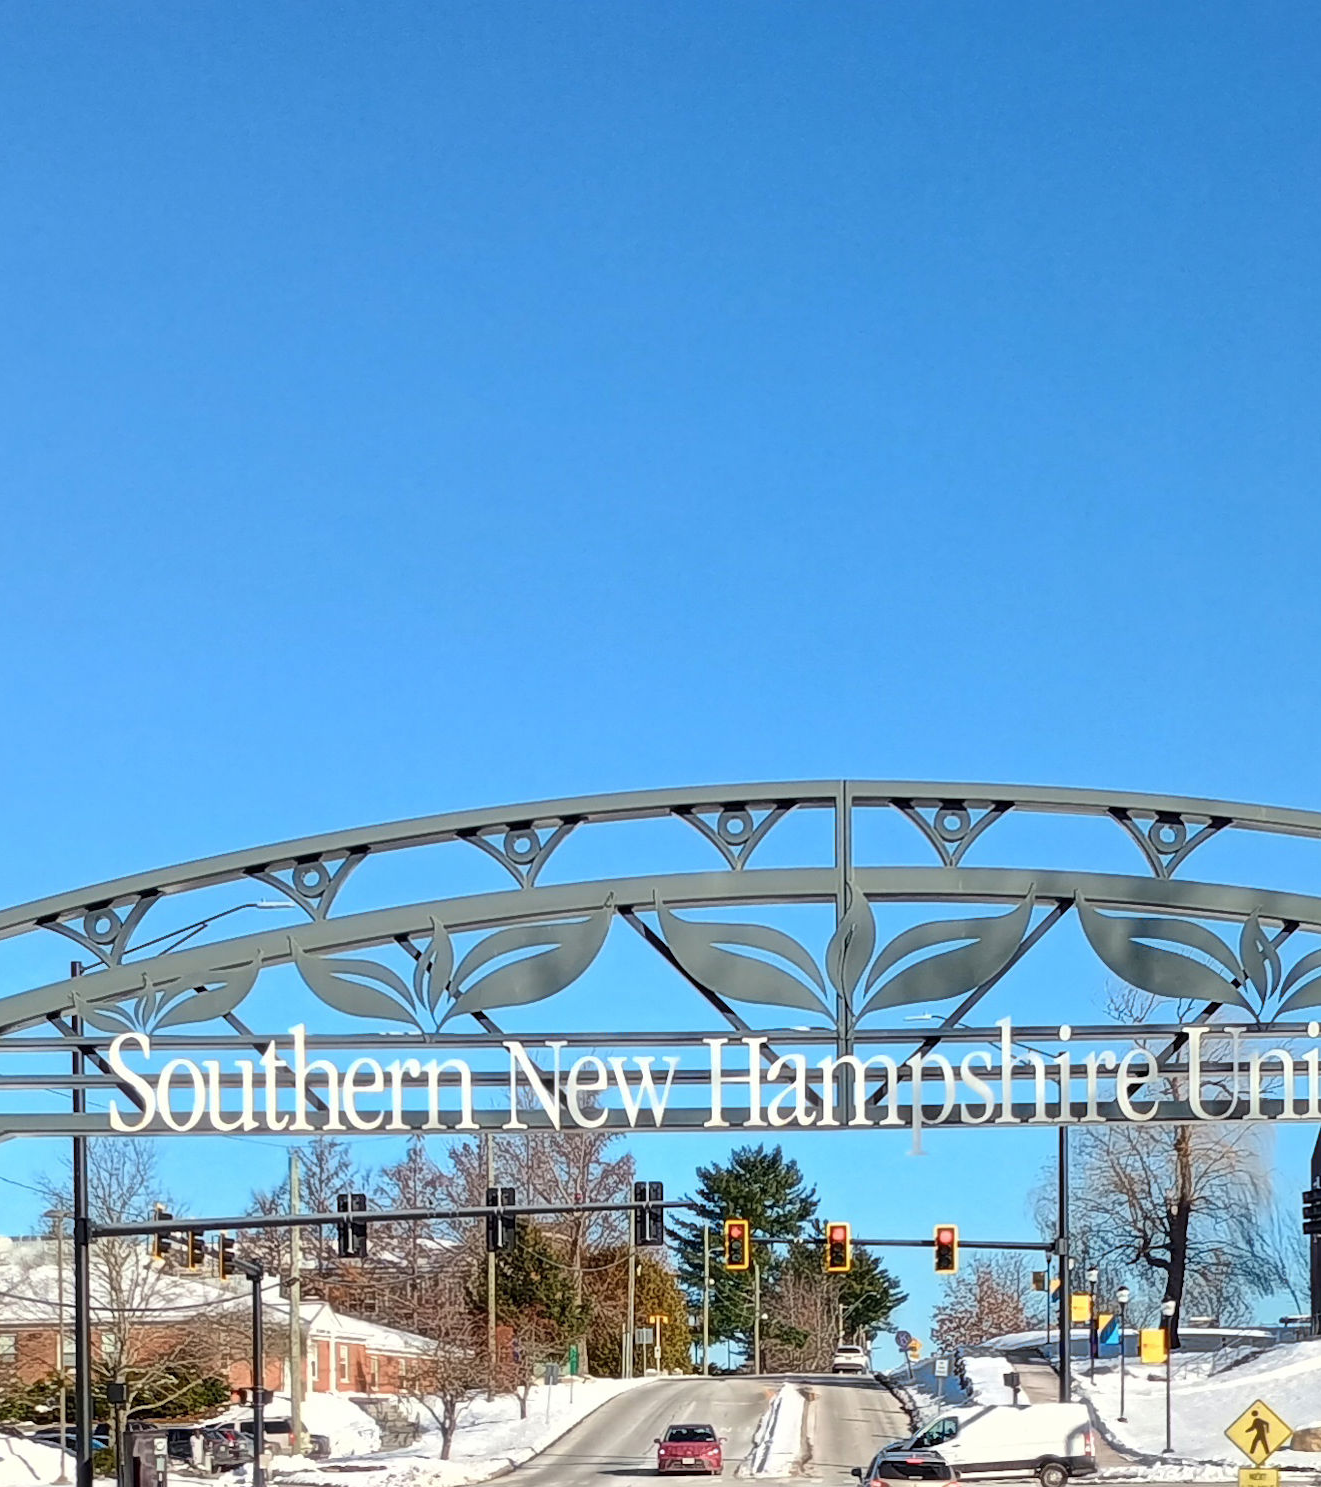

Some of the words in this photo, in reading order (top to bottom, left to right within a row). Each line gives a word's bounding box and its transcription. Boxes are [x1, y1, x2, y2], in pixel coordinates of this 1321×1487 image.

[108, 1024, 478, 1133] Southern
[503, 1039, 681, 1132] New
[702, 1016, 1158, 1156] Hampshire
